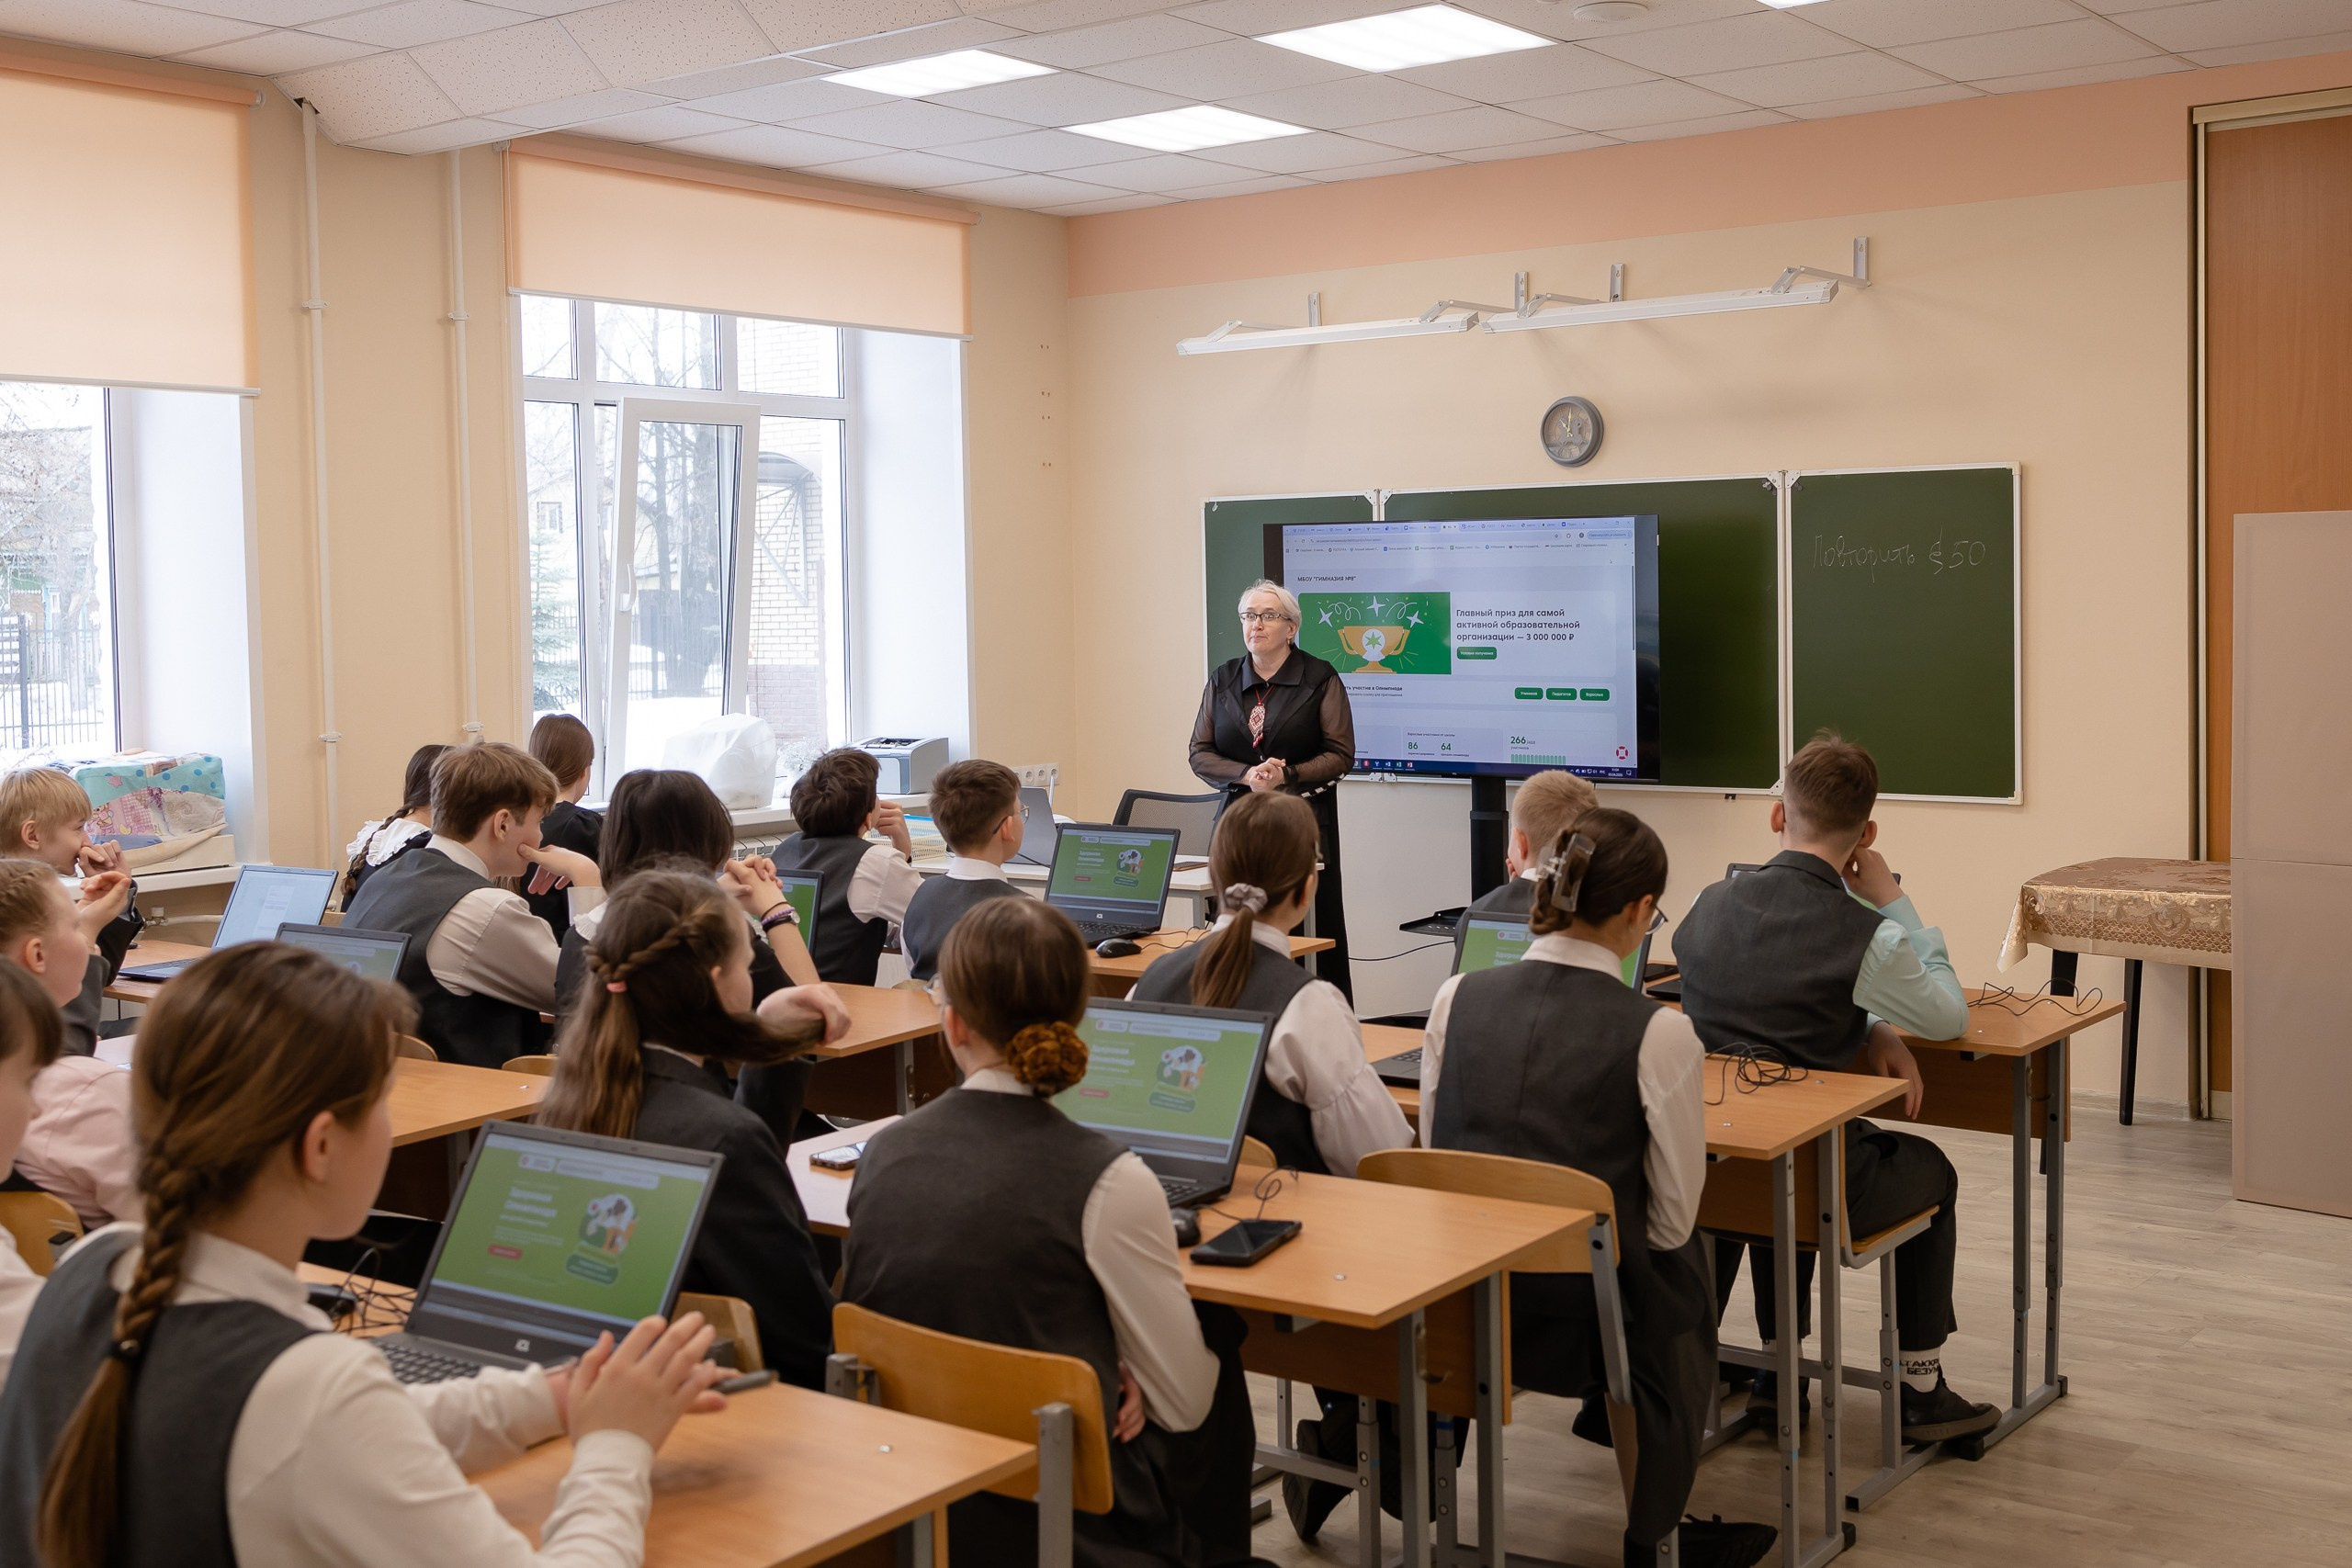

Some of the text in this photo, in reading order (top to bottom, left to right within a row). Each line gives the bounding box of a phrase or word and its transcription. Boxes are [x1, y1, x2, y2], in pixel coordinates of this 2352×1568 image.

[1813, 535, 1916, 583] Повторить
[1495, 610, 1516, 618] приз
[1500, 621, 1580, 630] образовательной
[1456, 634, 1514, 642] организации
[1510, 736, 1526, 744] 266
[1408, 741, 1419, 750] 86
[1441, 742, 1451, 750] 64
